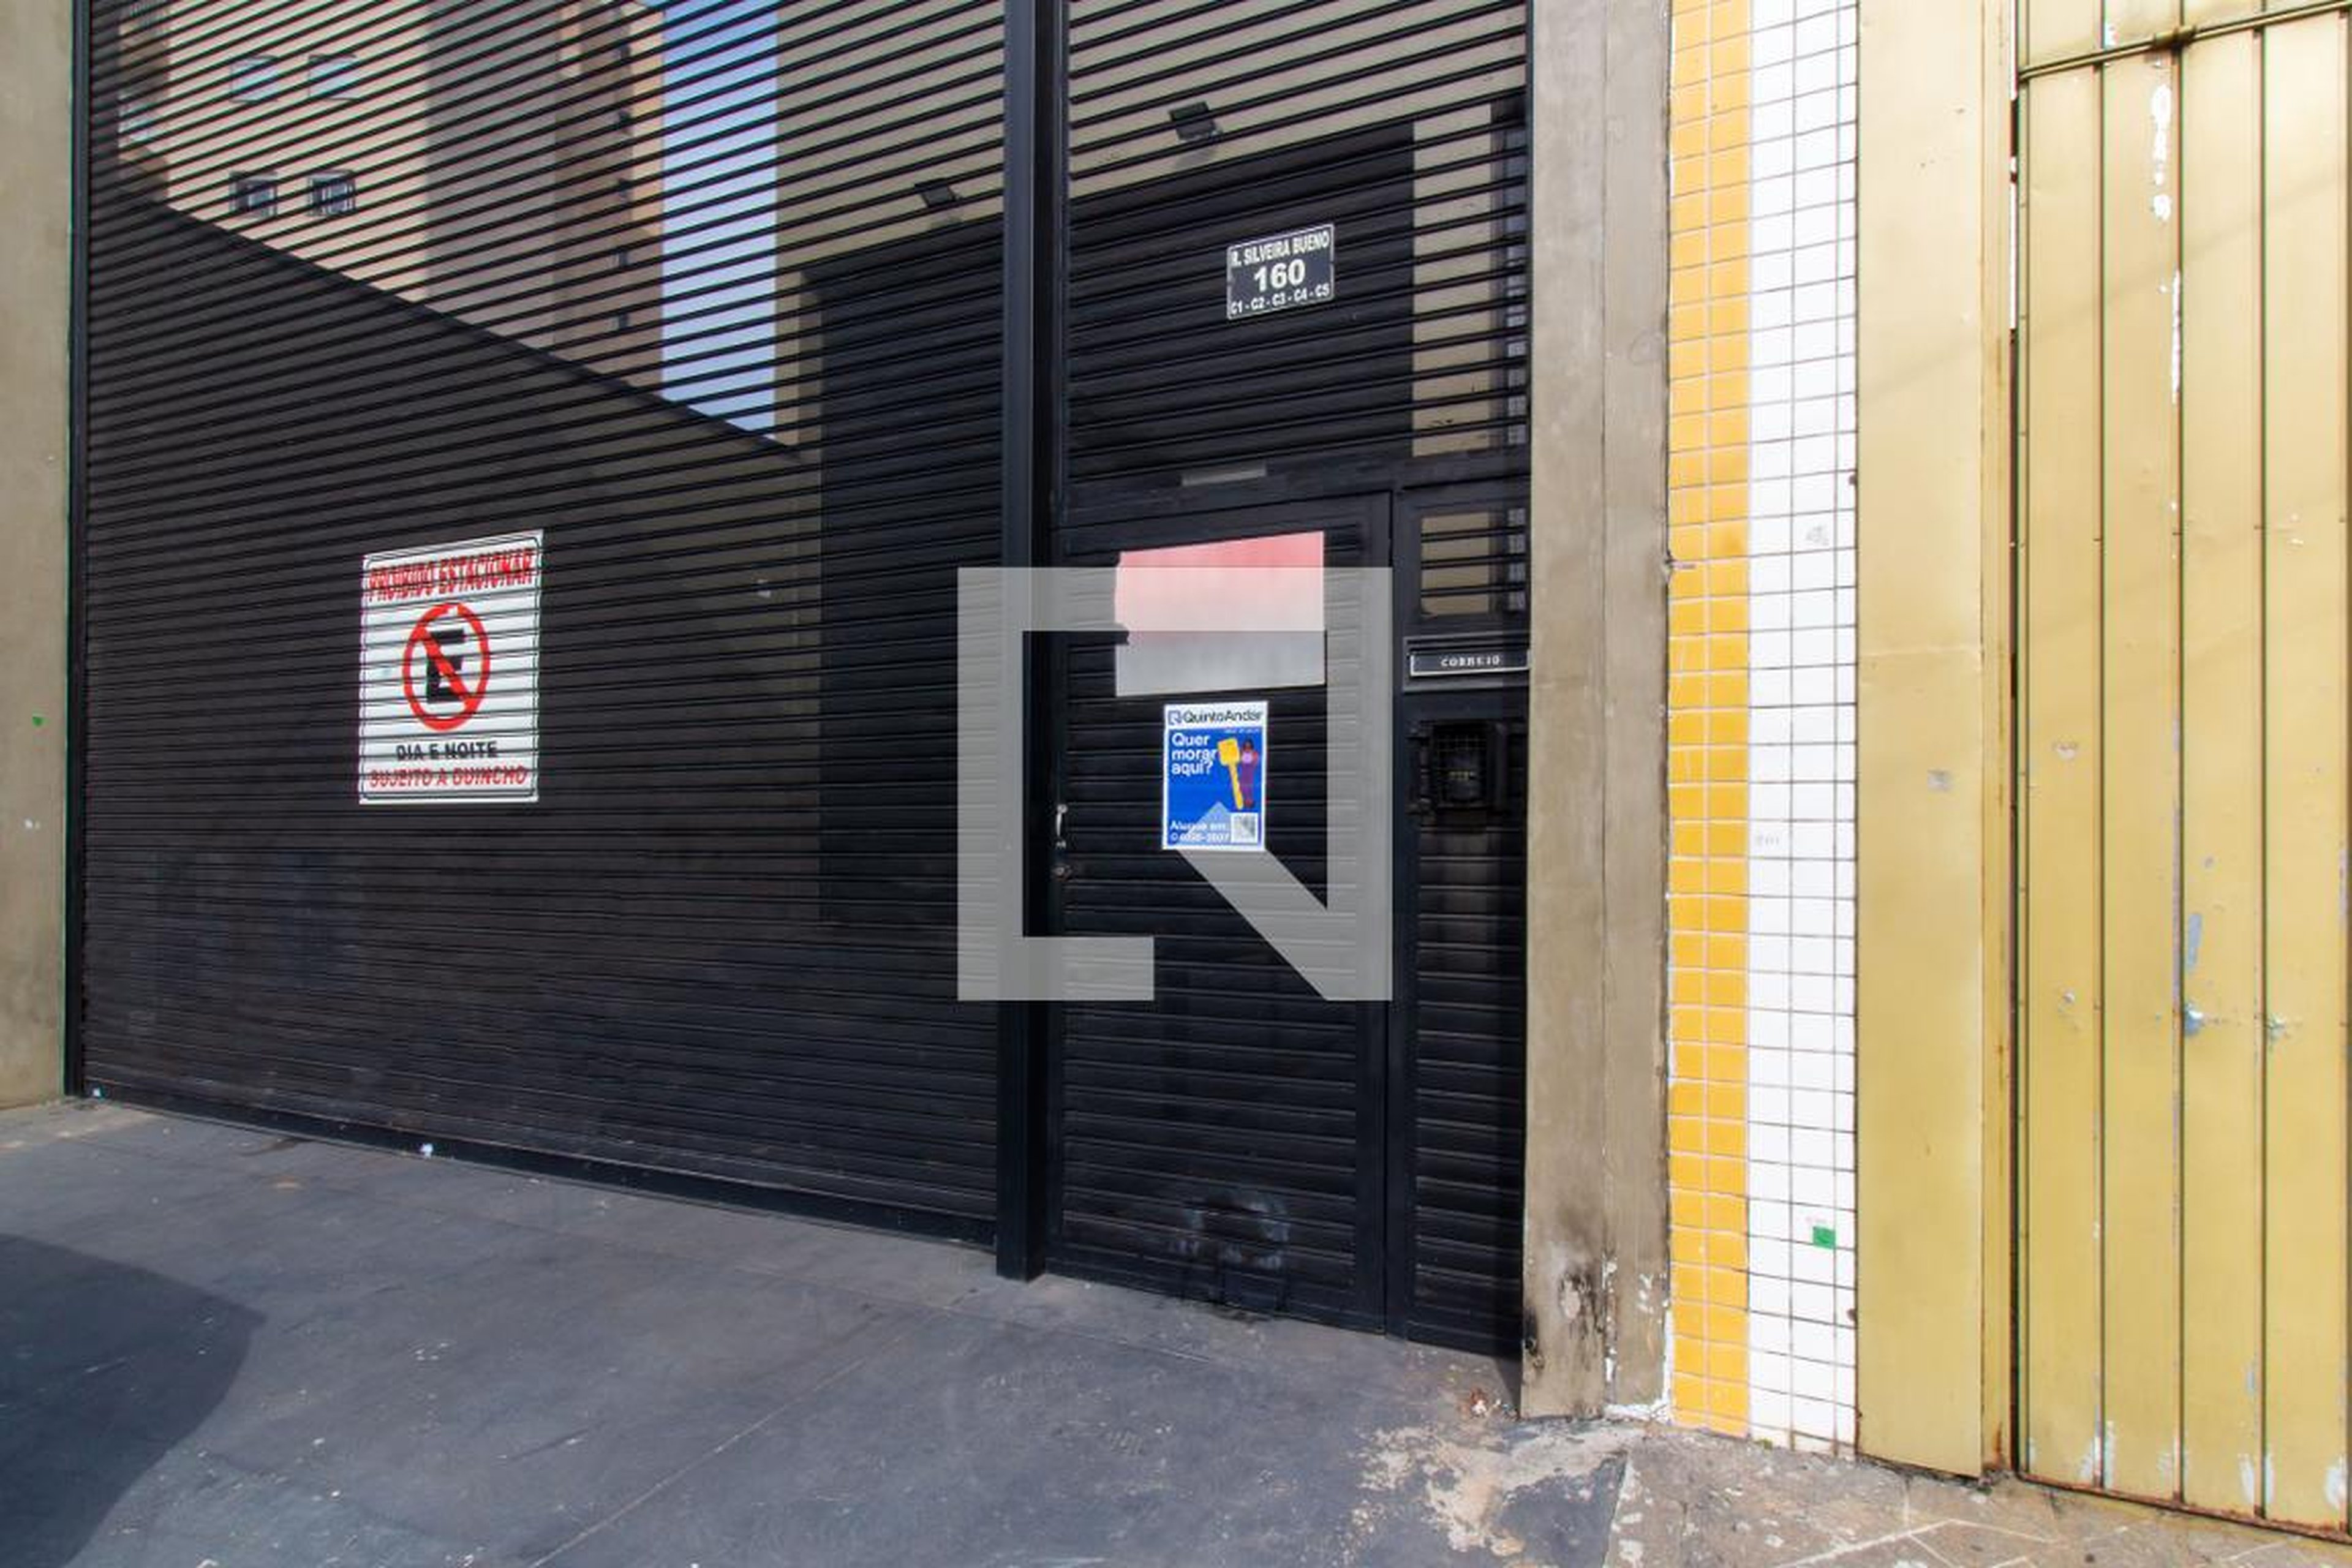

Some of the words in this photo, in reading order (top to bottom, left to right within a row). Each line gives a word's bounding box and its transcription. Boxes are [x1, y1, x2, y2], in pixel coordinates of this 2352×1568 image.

[1243, 239, 1291, 265] SILVEIRA
[1292, 230, 1330, 254] BUENO
[1254, 258, 1305, 292] 160
[1441, 654, 1500, 667] CORREIO
[1183, 709, 1262, 723] QuintoAndar
[1171, 732, 1211, 747] Quer
[396, 743, 424, 761] DIA
[430, 743, 440, 760] E
[445, 741, 499, 760] NOITE
[1171, 748, 1218, 761] morar
[370, 767, 433, 787] SUJEITO
[437, 767, 448, 786] A
[1170, 758, 1213, 777] aqui?
